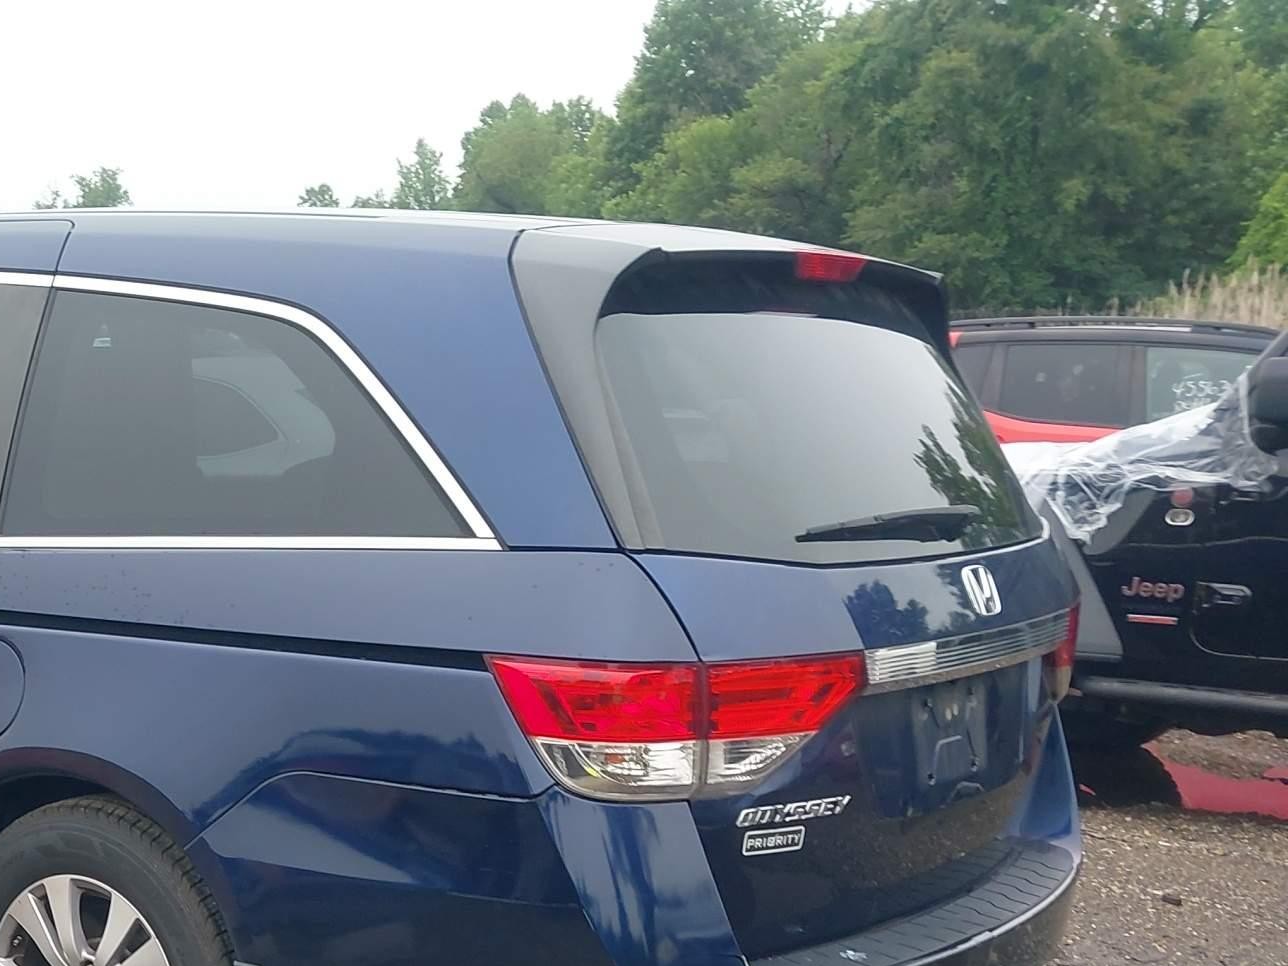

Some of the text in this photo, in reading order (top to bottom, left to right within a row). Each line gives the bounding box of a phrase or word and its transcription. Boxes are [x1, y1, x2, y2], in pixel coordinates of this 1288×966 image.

[1121, 577, 1185, 603] Jeep
[736, 795, 852, 827] ODYSSEY
[746, 833, 801, 850] PRIORITY
